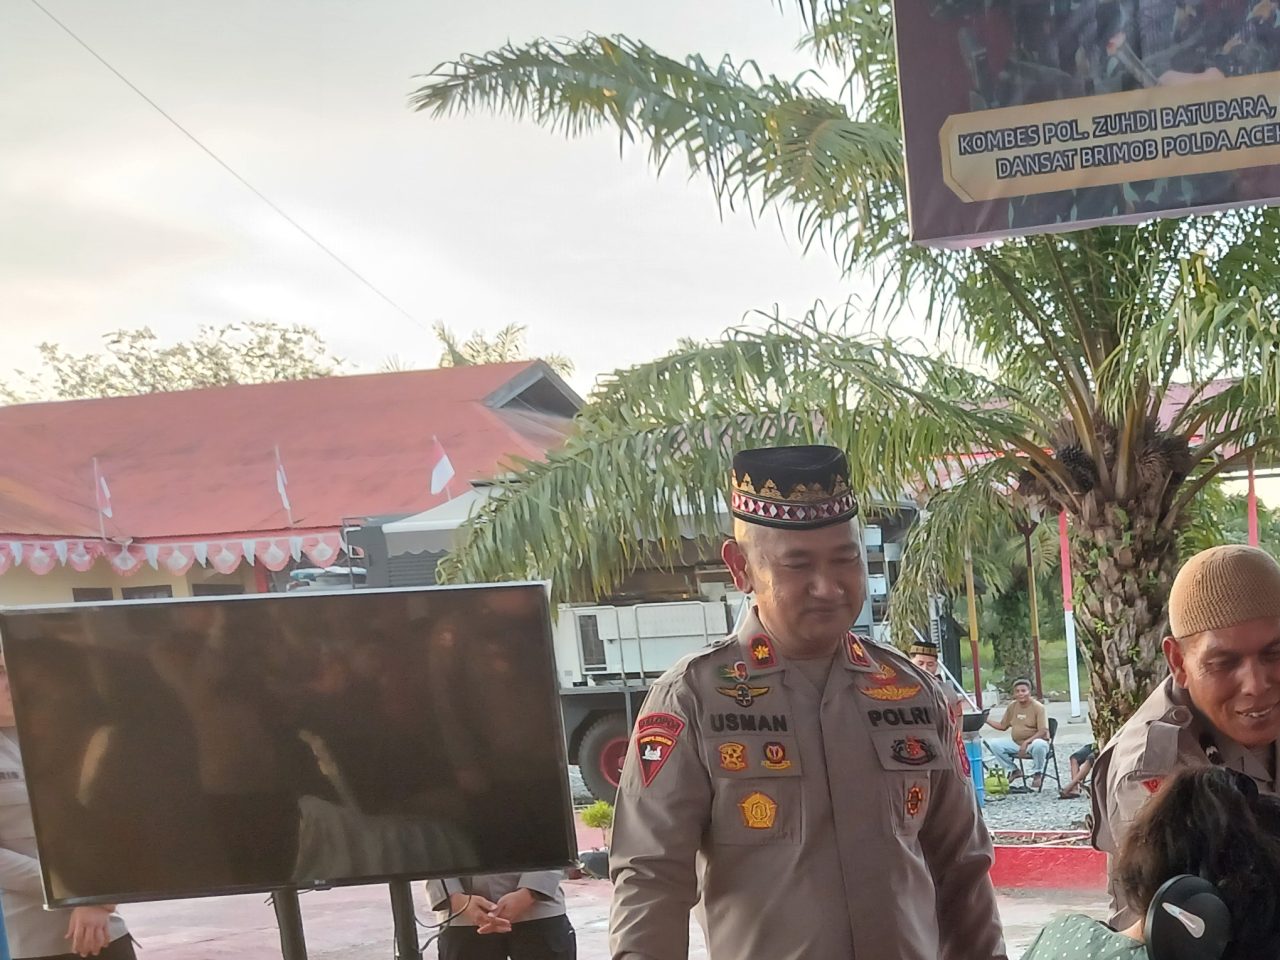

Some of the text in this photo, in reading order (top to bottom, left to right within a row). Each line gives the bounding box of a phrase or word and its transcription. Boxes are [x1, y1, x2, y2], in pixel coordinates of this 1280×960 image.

[959, 123, 1040, 155] KOMBES
[1043, 120, 1089, 144] POL.
[1093, 108, 1158, 139] ZUHDI
[1160, 94, 1277, 129] BATUBARA,
[997, 148, 1079, 179] DANSAT
[1081, 138, 1158, 169] BRIMOB
[1161, 128, 1235, 160] POLDA
[710, 712, 788, 732] USMAN
[867, 706, 933, 728] POLRI
